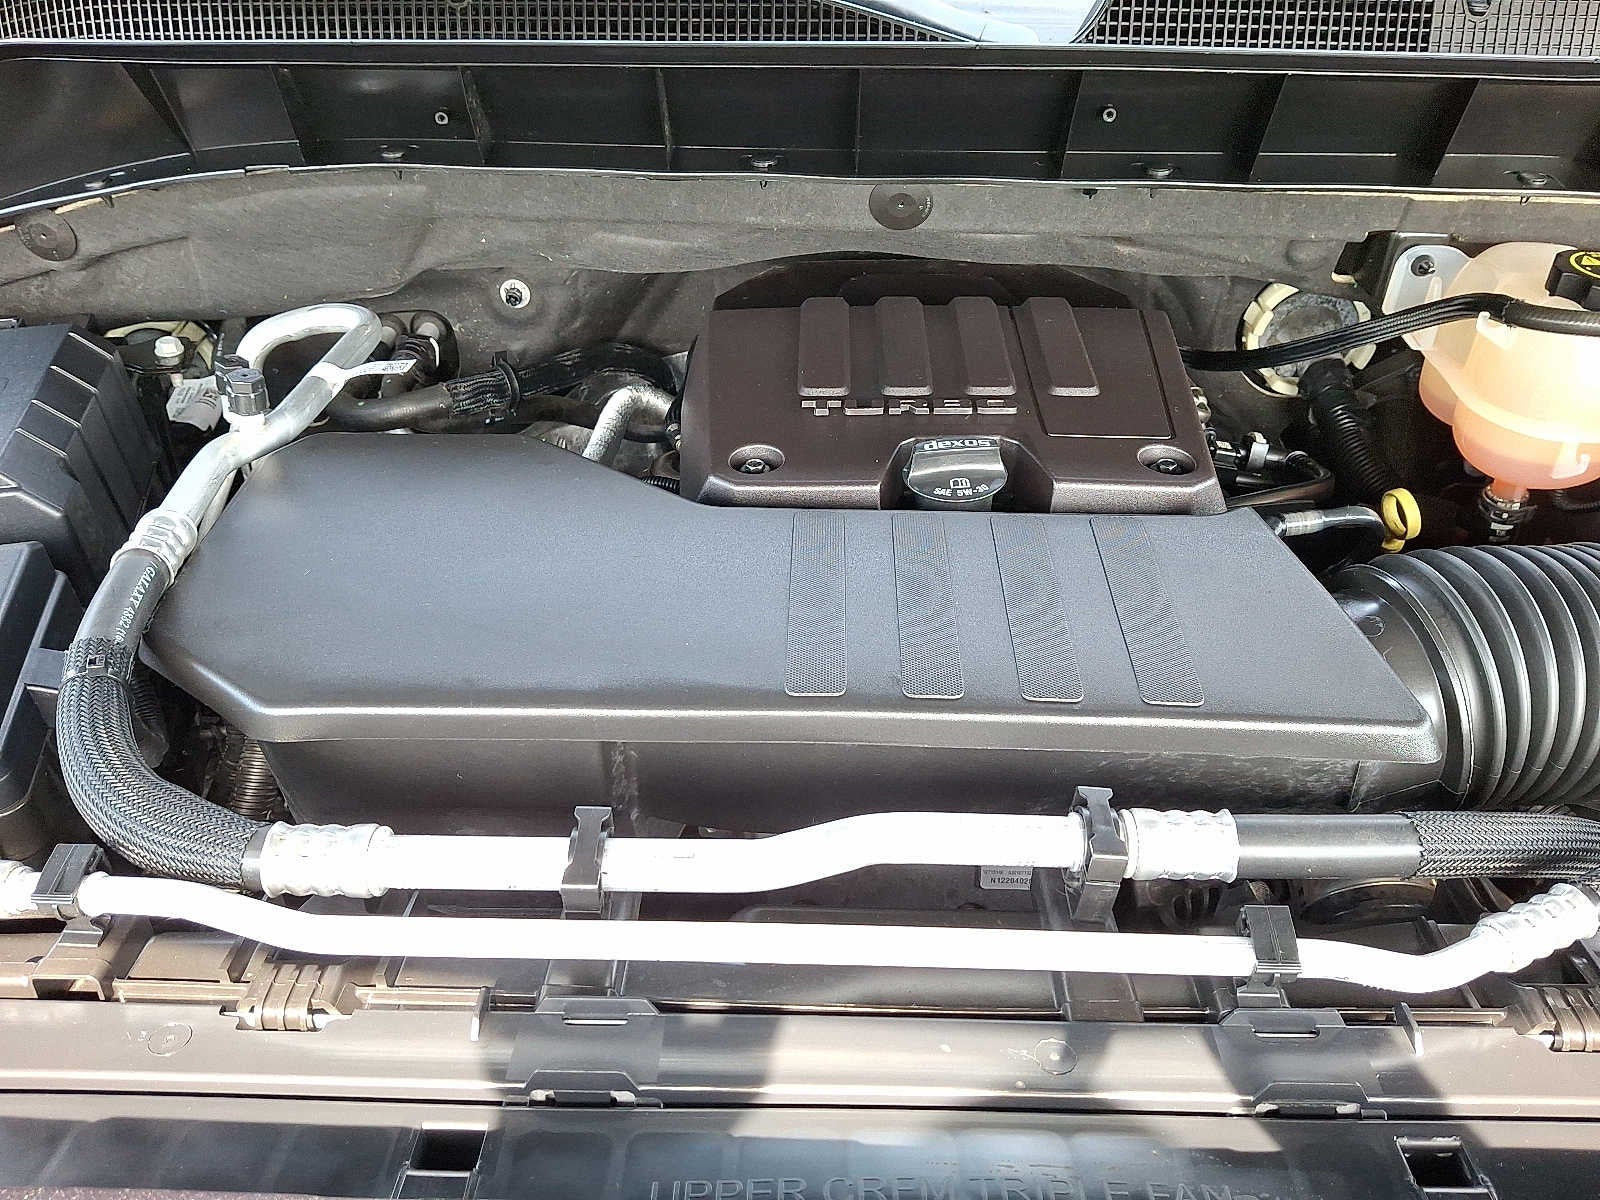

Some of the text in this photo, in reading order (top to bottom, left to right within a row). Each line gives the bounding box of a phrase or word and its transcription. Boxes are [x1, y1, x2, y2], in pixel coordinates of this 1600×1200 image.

[923, 439, 992, 451] dexos
[933, 487, 953, 497] SAE
[129, 565, 156, 609] GALAXY
[650, 1177, 808, 1200] UPPER
